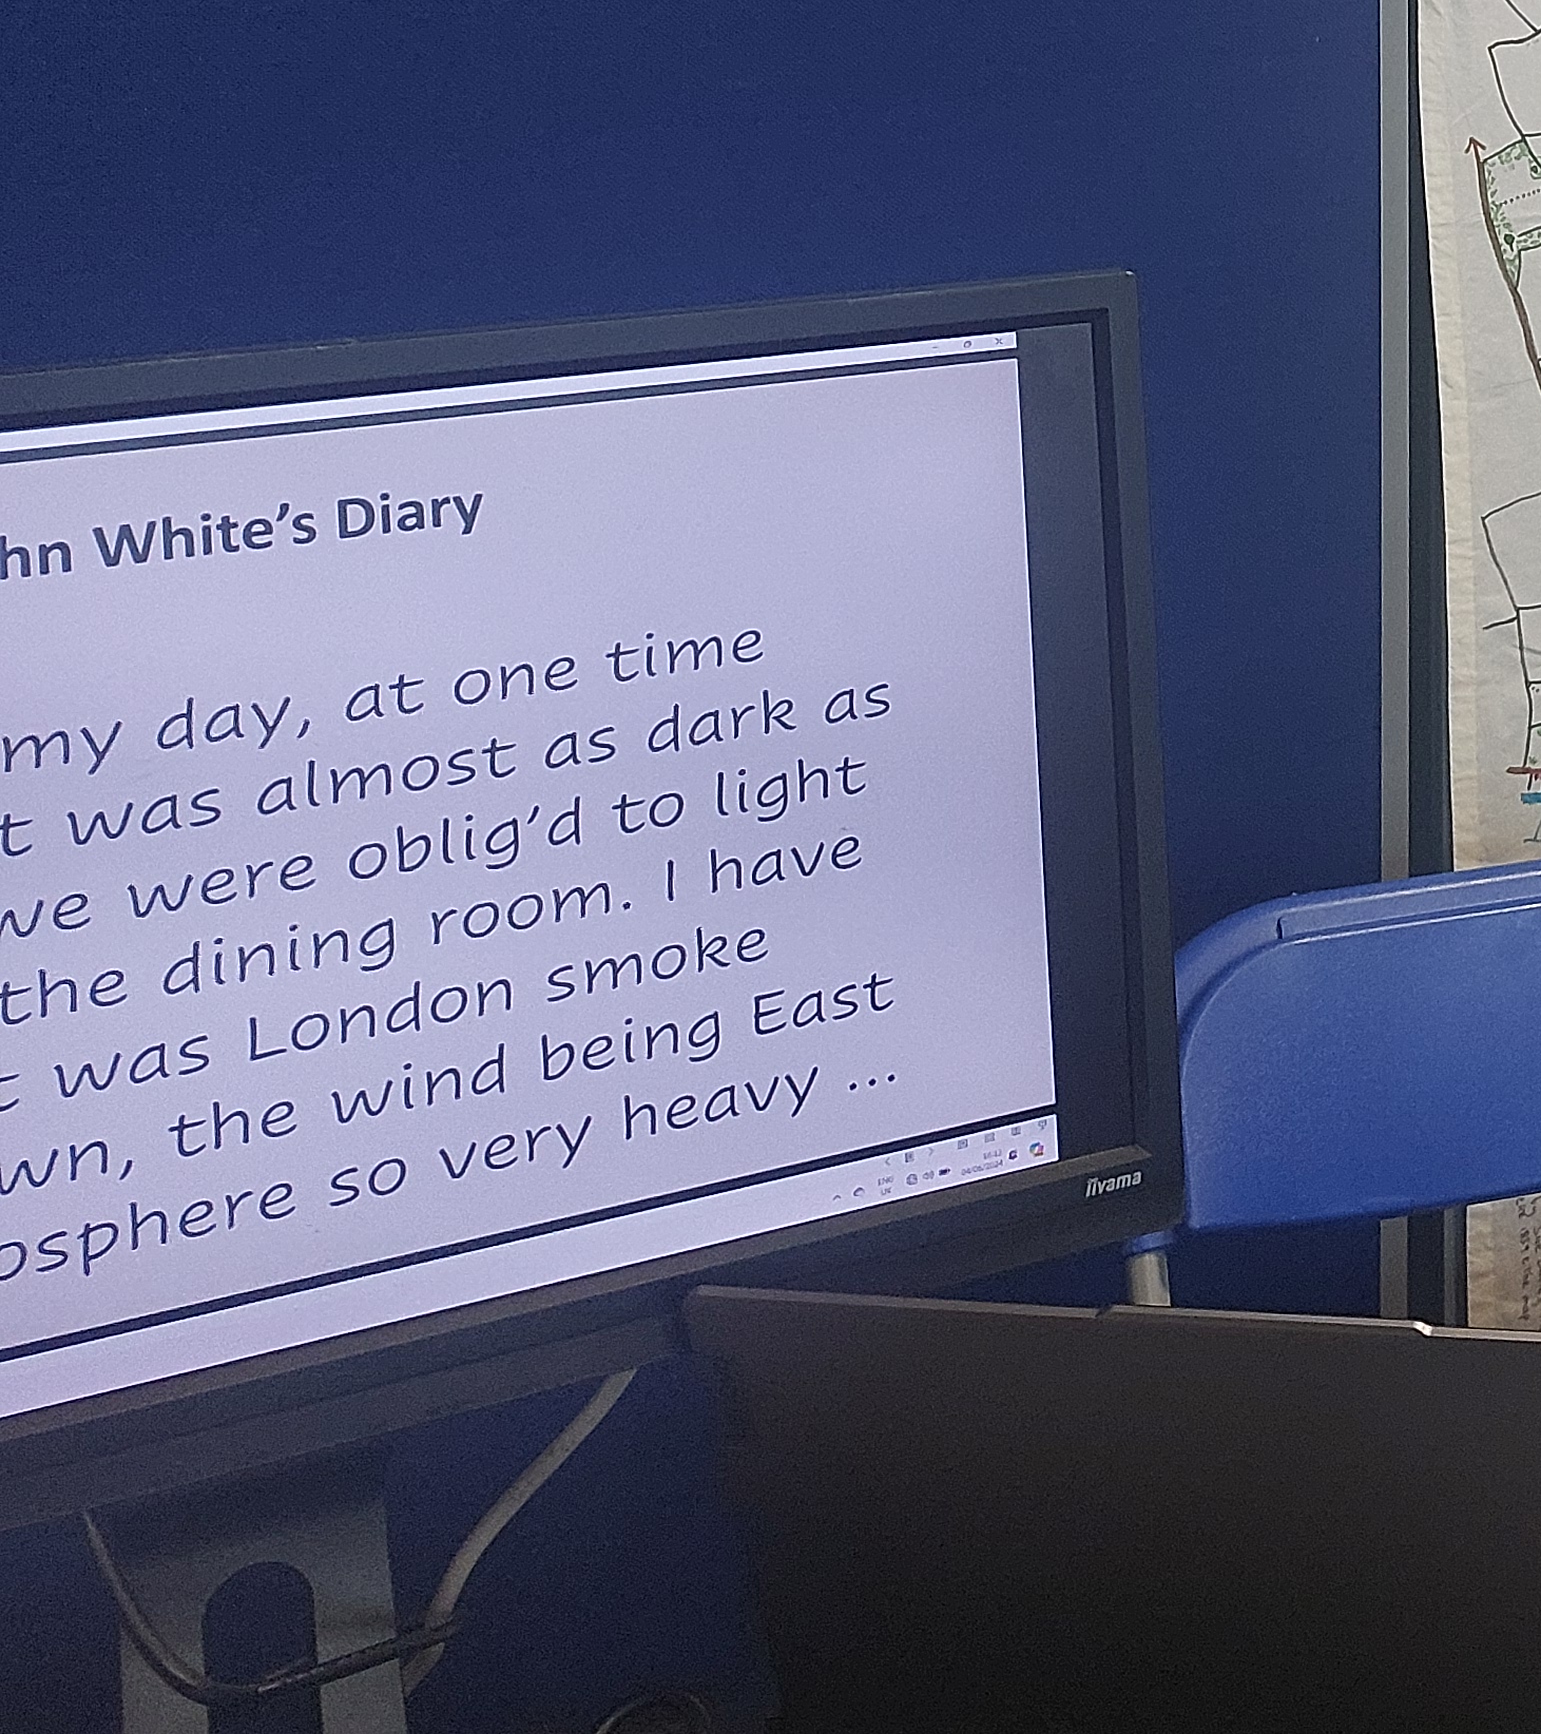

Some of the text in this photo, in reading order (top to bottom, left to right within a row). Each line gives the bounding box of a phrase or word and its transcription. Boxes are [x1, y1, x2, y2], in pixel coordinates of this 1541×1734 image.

[92, 502, 317, 568] White's
[337, 492, 484, 540] Diary
[1, 629, 764, 776] my day, at one time
[66, 788, 222, 846] was
[256, 737, 517, 816] almost
[544, 726, 617, 770] as
[647, 689, 797, 753] dark
[824, 683, 891, 725] as
[126, 854, 317, 919] were
[348, 795, 581, 880] oblig'd
[611, 792, 685, 834] to
[716, 756, 867, 823] light
[0, 836, 862, 1026] the dining room. I have
[53, 926, 769, 1099] was London smoke
[167, 1100, 298, 1158] the
[330, 1042, 506, 1124] wind
[540, 1010, 721, 1081] being
[753, 972, 895, 1036] East
[329, 1157, 407, 1207] so
[438, 1115, 593, 1180] very
[623, 1066, 819, 1141] heavy
[848, 1073, 896, 1092] ...
[1084, 1169, 1143, 1198] iiyama
